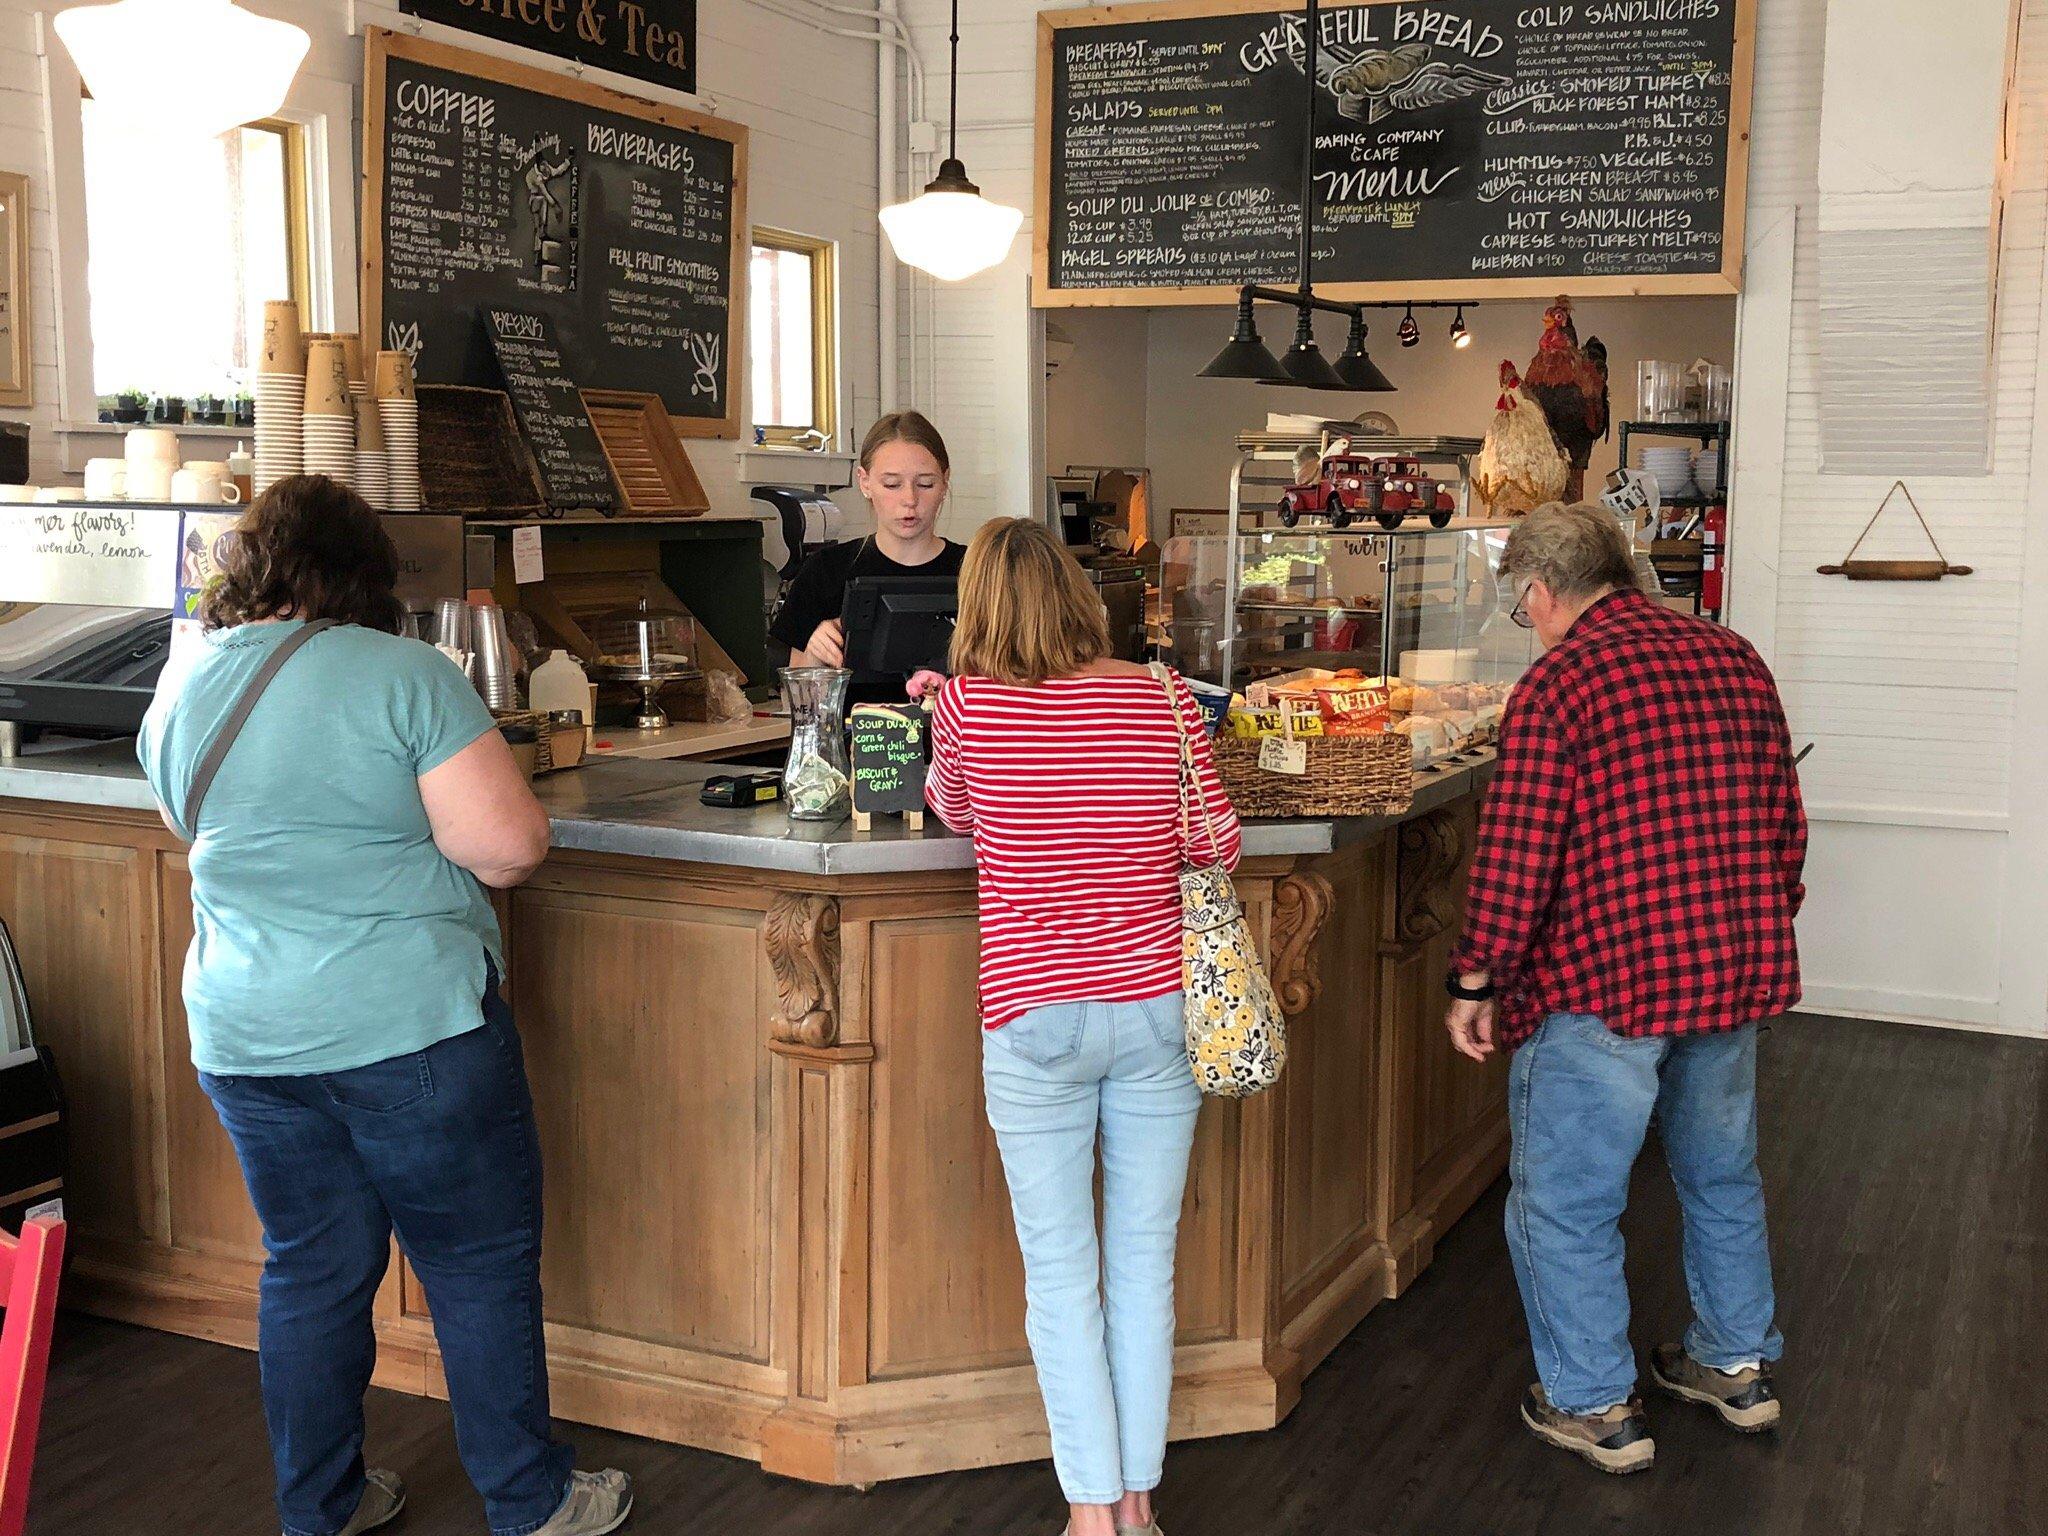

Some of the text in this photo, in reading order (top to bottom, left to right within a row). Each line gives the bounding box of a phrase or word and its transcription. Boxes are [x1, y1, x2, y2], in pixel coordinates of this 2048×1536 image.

[1517, 0, 1719, 28] COLD SANDWICHES
[577, 0, 606, 45] &
[619, 1, 686, 70] Tea
[1240, 6, 1503, 73] GRAEFUL BREAD
[1066, 39, 1148, 63] BREAKFAST
[1560, 76, 1632, 94] SMOKED
[1634, 71, 1712, 91] TURKEY
[397, 80, 495, 128] COFFEE
[1068, 101, 1142, 122] SALADS
[1533, 97, 1576, 113] BLACK
[1579, 95, 1639, 111] FOREST
[1645, 92, 1686, 109] HAM
[1486, 118, 1526, 135] CLUB
[587, 123, 694, 174] BEVERAGES
[1315, 129, 1444, 149] BAKING COMPANY
[1351, 146, 1400, 162] & CAFE
[1484, 156, 1563, 172] HUMMUS
[1600, 152, 1674, 167] VEGGIE
[1536, 171, 1601, 186] CHICKEN
[1605, 169, 1661, 187] BREAST
[1067, 197, 1116, 217] SOUP
[1121, 196, 1144, 215] DU
[1150, 193, 1196, 213] JOUR
[1510, 188, 1582, 203] CHICKEN
[1588, 187, 1632, 202] SALAD
[1507, 208, 1692, 230] HOT SANDWICHES
[1481, 233, 1556, 249] CAPRESE
[1588, 233, 1649, 248] TURKEY
[1651, 230, 1694, 247] MELT
[635, 250, 664, 272] FRUIT
[666, 257, 719, 281] SMOOTHIES
[1061, 248, 1111, 267] BAGEL
[1116, 246, 1187, 265] SPREADS
[100, 542, 152, 558] lemon
[856, 718, 923, 729] SOUP DU JOUR
[857, 767, 889, 780] BISCUIT
